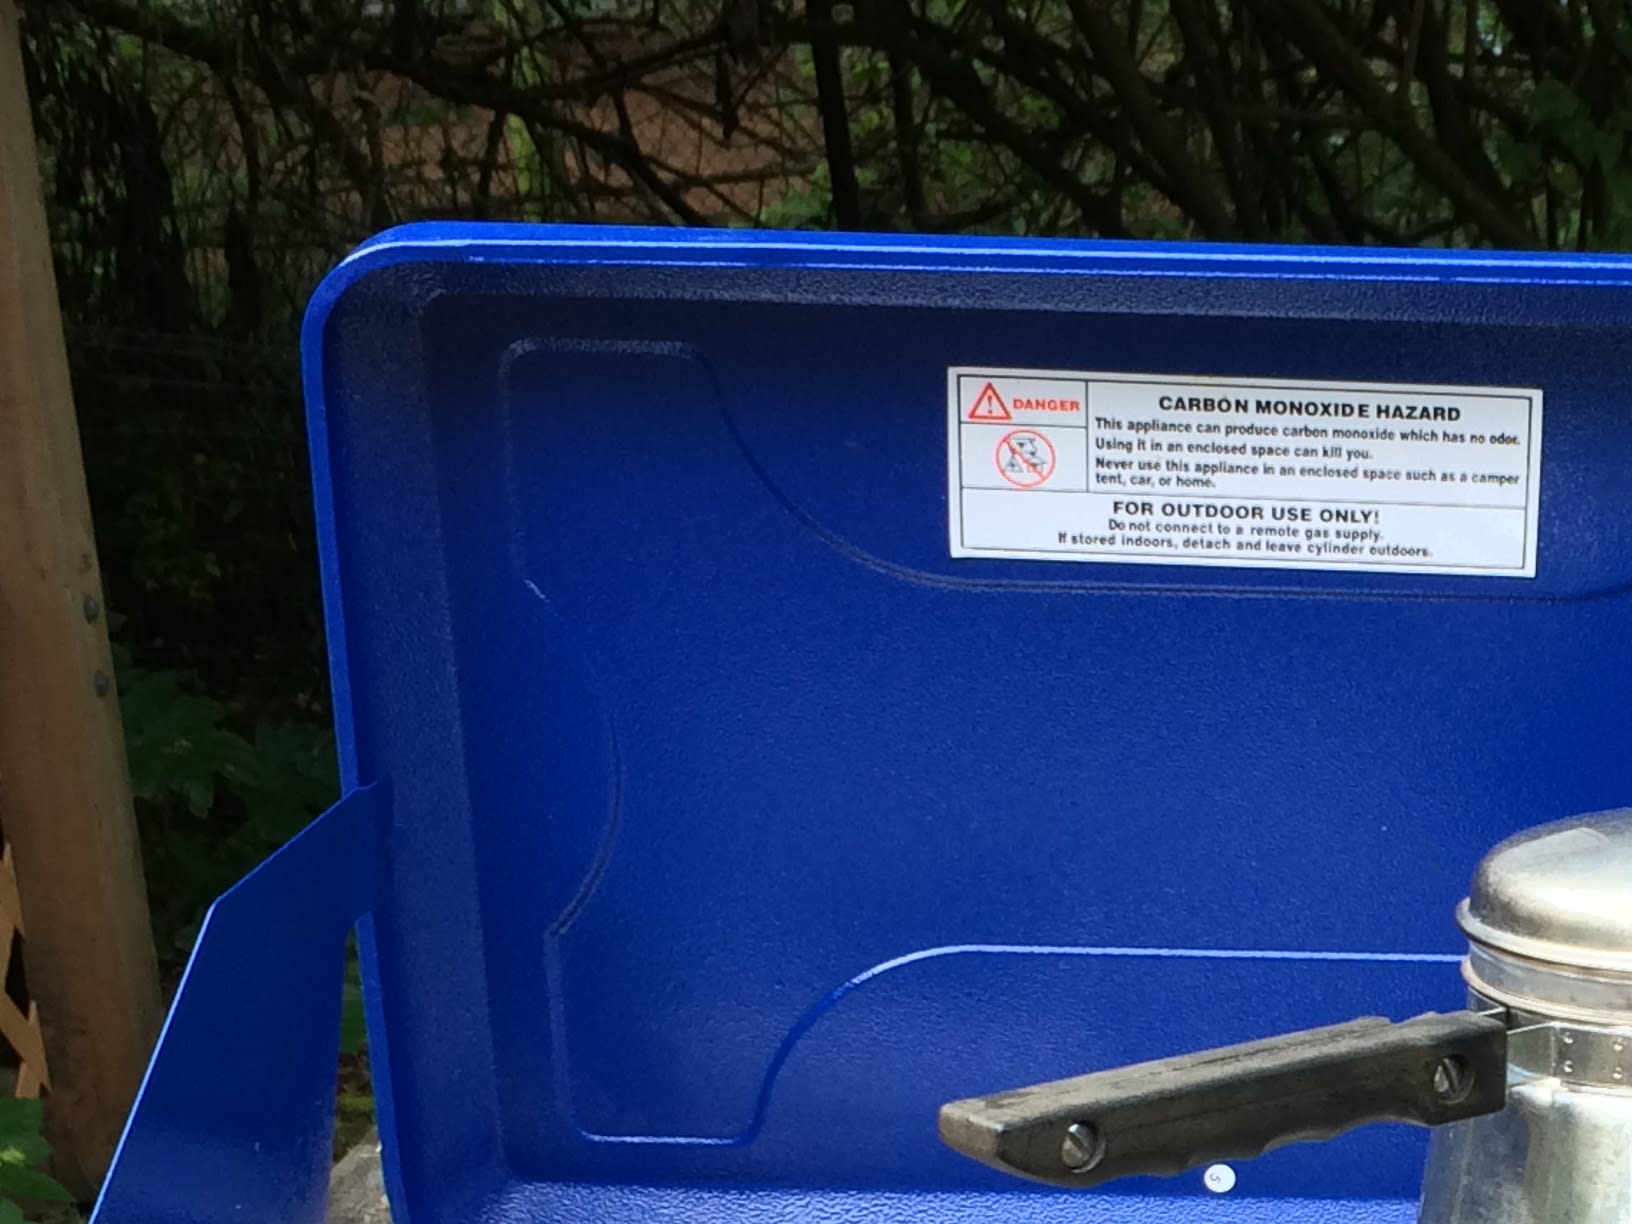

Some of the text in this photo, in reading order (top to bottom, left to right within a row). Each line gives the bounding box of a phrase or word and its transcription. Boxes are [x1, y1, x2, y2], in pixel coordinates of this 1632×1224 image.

[1013, 398, 1081, 412] DANGER
[1158, 396, 1461, 421] CARBON MONOXIDE HAZARD
[1096, 417, 1123, 431] This
[1127, 418, 1193, 434] appliance
[1196, 423, 1220, 434] can
[1224, 422, 1279, 437] produce
[1282, 425, 1328, 438] carbon
[1332, 427, 1395, 441] monoxide
[1400, 429, 1438, 442] which
[1442, 431, 1465, 443] has
[1470, 434, 1486, 445] no
[1096, 437, 1133, 454] Using
[1137, 439, 1147, 451] it
[1151, 440, 1163, 452] in
[1168, 443, 1182, 453] an
[1187, 441, 1247, 456] enclosed
[1251, 446, 1290, 459] space
[1294, 447, 1318, 458] can
[1096, 457, 1133, 471] Never
[1138, 460, 1161, 472] use
[1166, 459, 1189, 472] this
[1194, 461, 1258, 477] appliance
[1263, 463, 1275, 475] in
[1279, 466, 1295, 477] an
[1300, 465, 1358, 479] enclosed
[1363, 468, 1400, 482] space
[1406, 468, 1437, 481] such
[1441, 472, 1456, 482] as
[1460, 473, 1468, 483] a
[1159, 477, 1172, 487] or
[1113, 501, 1380, 524] FOR OUTDOOR USE ONLY!
[1108, 519, 1125, 531] Do
[1129, 520, 1151, 532] not
[1155, 521, 1213, 535] connect
[1217, 524, 1230, 535] to
[1250, 525, 1299, 538] remote
[1304, 528, 1329, 541] gas
[1071, 533, 1116, 546] stored
[1182, 537, 1230, 550] detach
[1236, 539, 1261, 551] and
[1265, 540, 1301, 553] leave
[1306, 542, 1364, 556] cylinder
